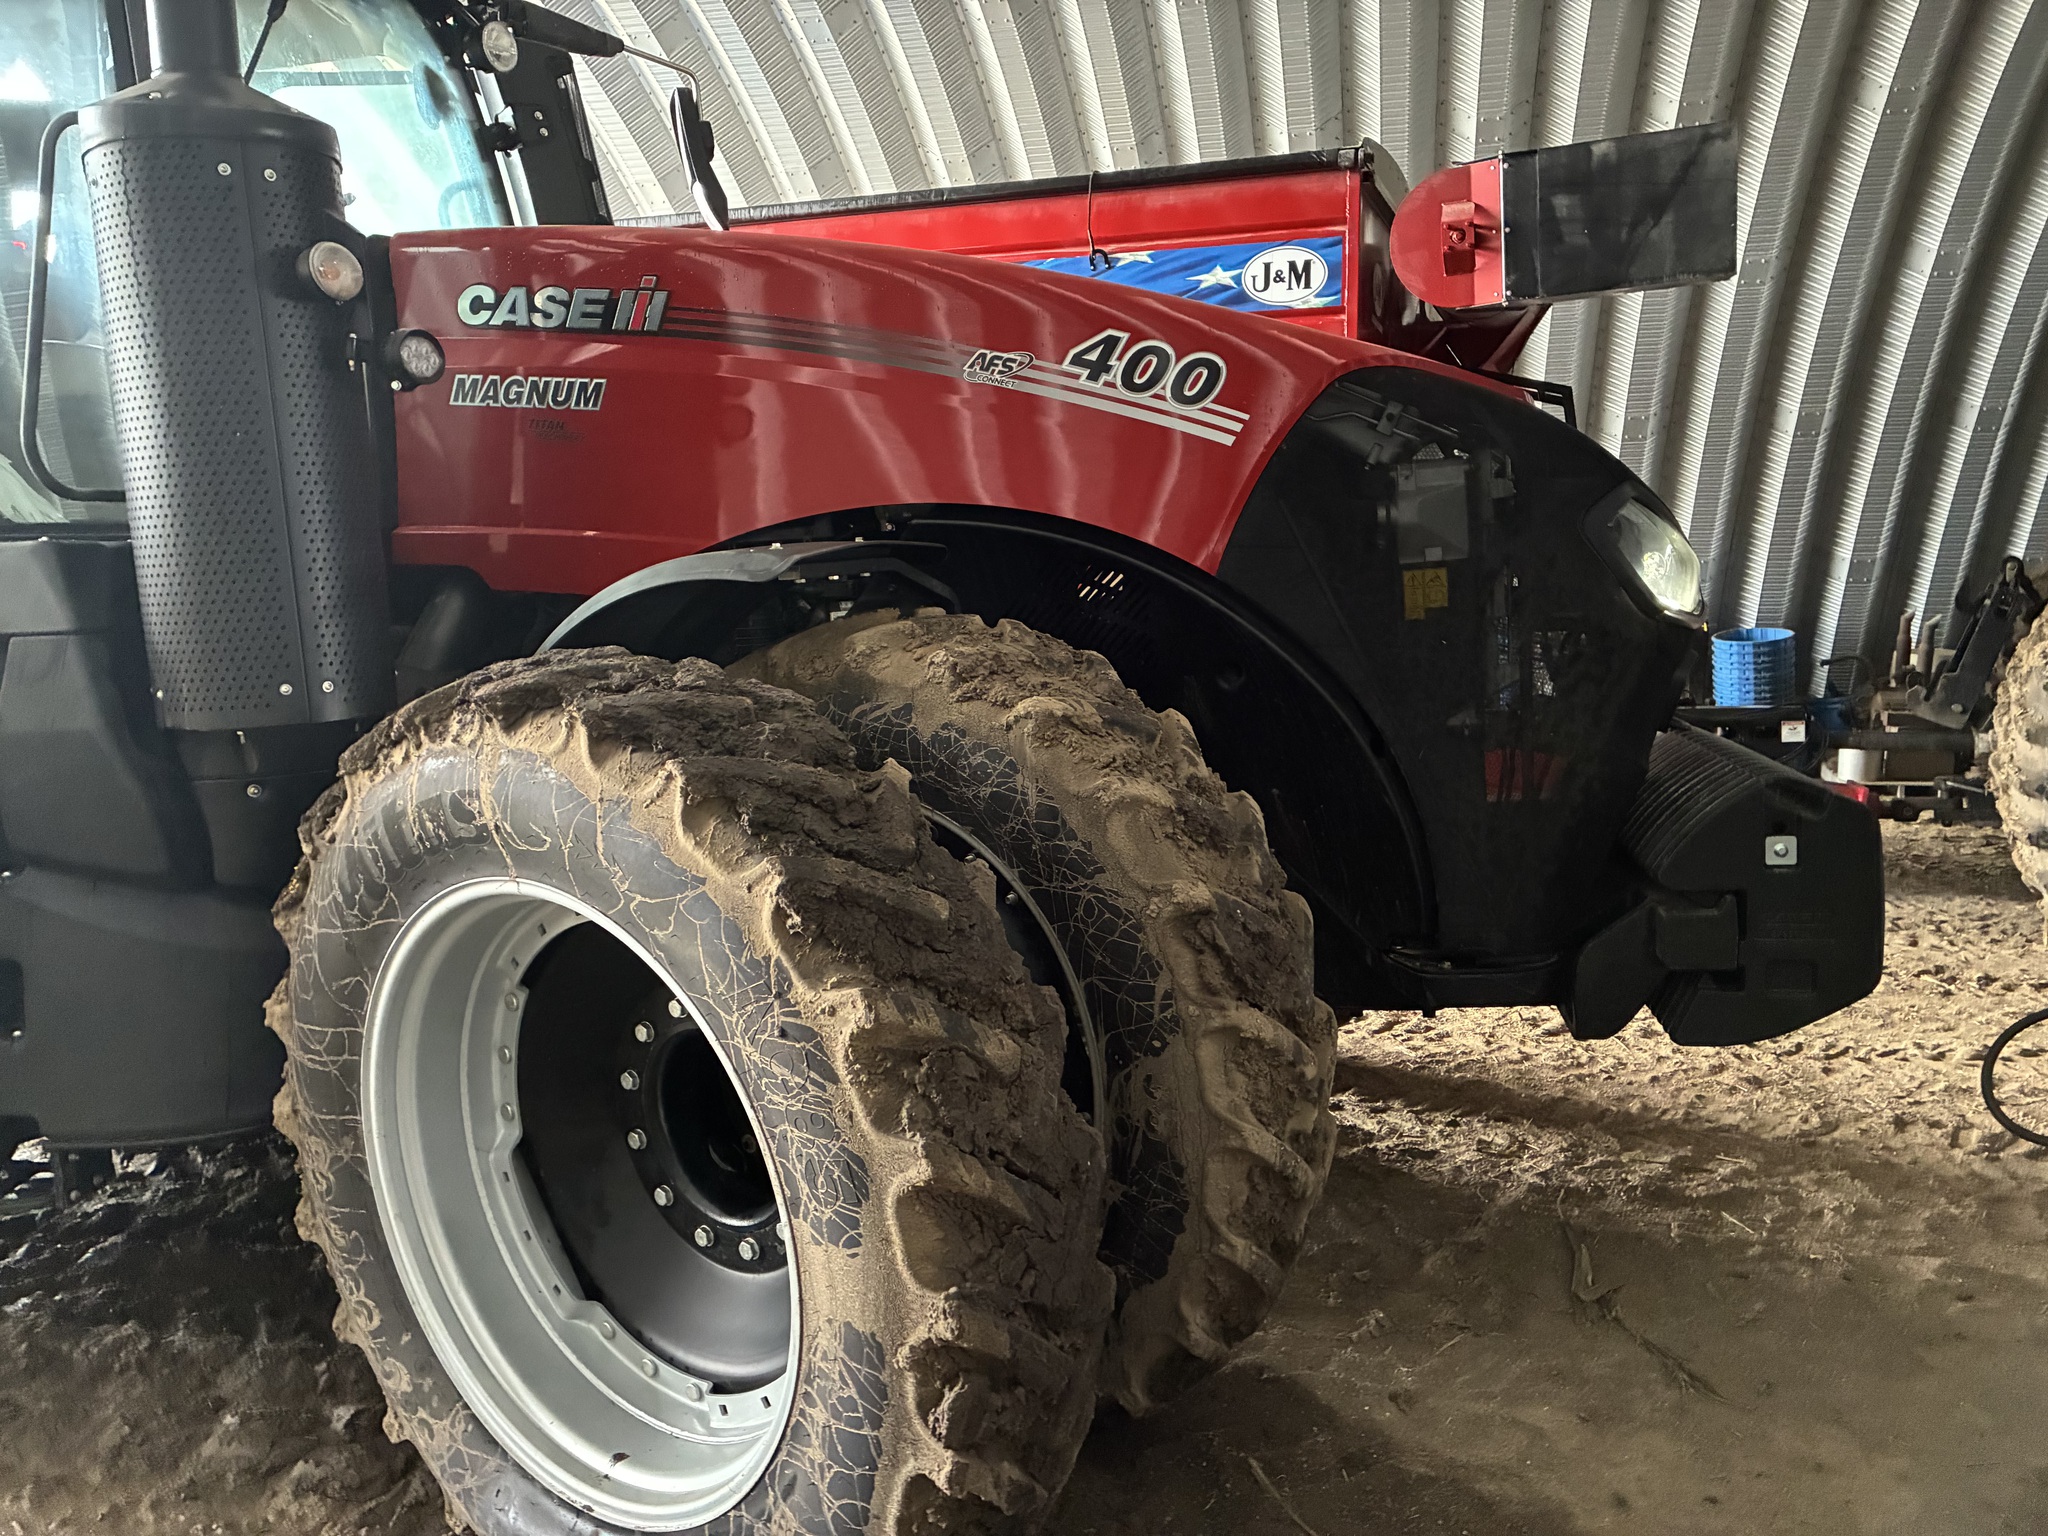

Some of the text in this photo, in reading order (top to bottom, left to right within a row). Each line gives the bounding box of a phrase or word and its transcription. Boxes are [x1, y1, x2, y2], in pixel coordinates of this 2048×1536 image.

[1252, 259, 1314, 293] J&M
[457, 284, 610, 328] CASE
[964, 349, 1019, 376] AFS
[1061, 328, 1227, 411] 400
[449, 374, 607, 411] MAGNUM
[976, 374, 1016, 388] CONNECT
